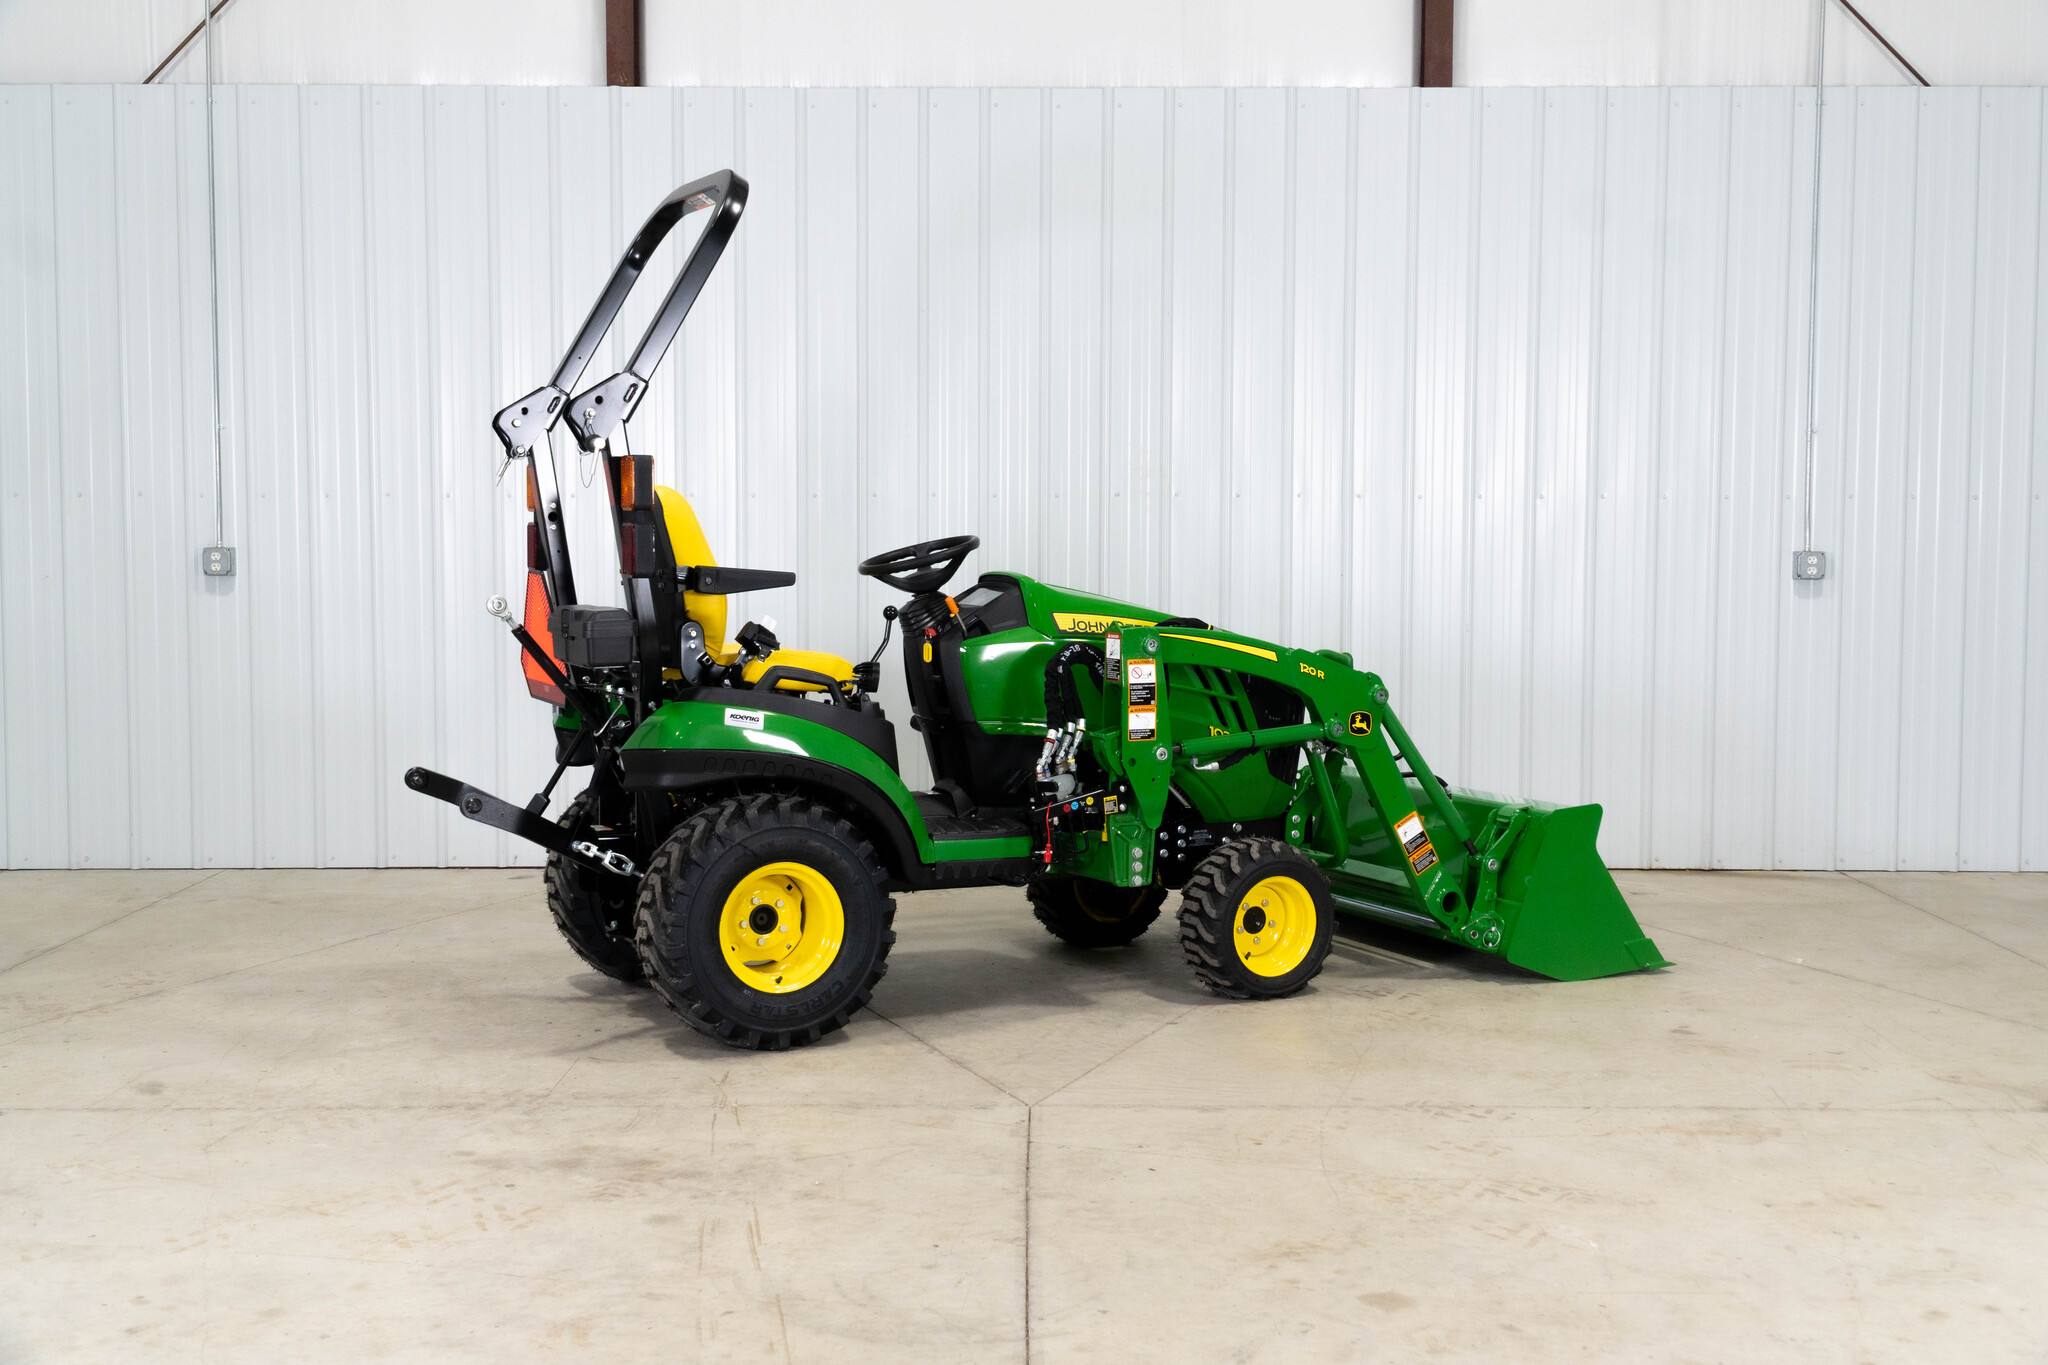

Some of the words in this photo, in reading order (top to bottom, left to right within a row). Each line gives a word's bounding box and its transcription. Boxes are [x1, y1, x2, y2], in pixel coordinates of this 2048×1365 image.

[1068, 618, 1109, 632] JOHN
[1299, 662, 1316, 676] 120
[1317, 669, 1325, 680] R
